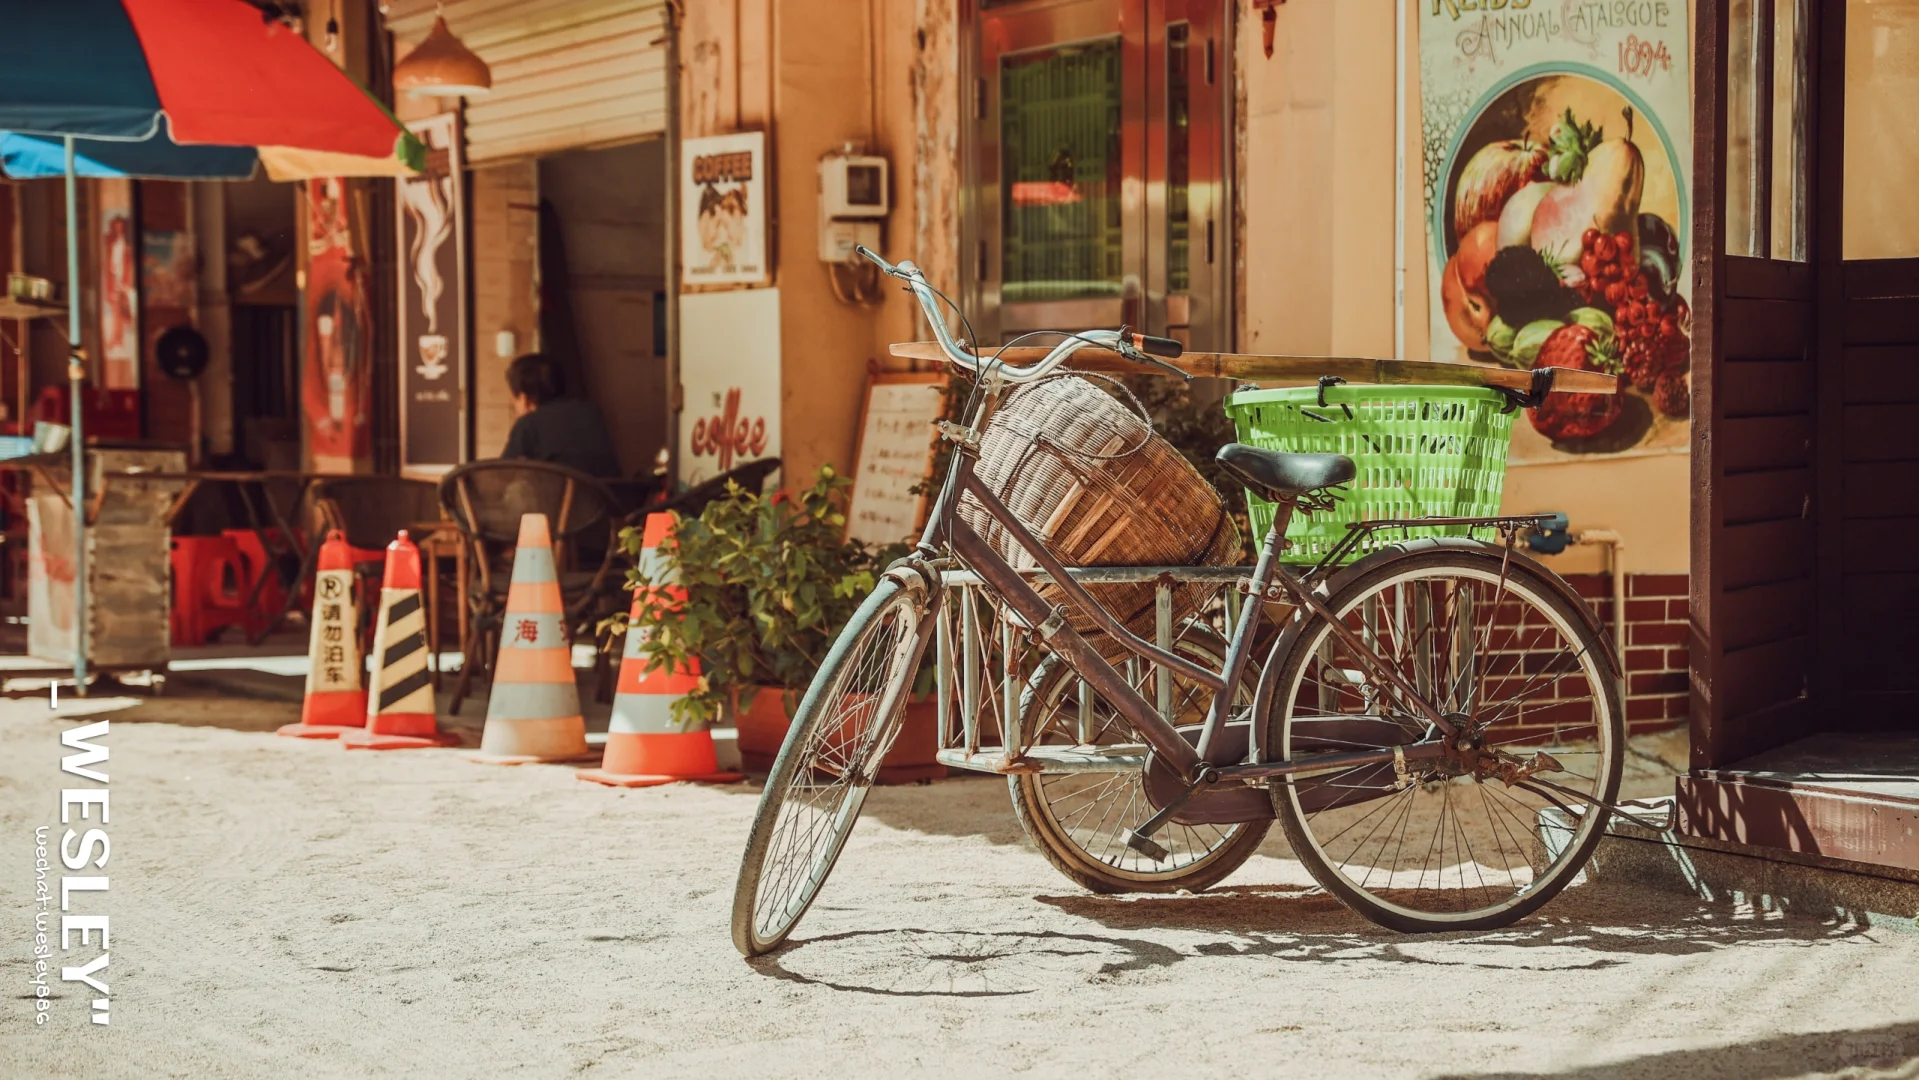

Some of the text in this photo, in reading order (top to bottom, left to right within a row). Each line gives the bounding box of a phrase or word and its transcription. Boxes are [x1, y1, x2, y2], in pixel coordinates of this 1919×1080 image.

[1455, 9, 1560, 63] ANNUAL
[1561, 0, 1669, 45] CATALOGUE
[1618, 34, 1671, 76] 1894
[693, 151, 753, 185] COFFEE
[692, 387, 769, 471] coffee
